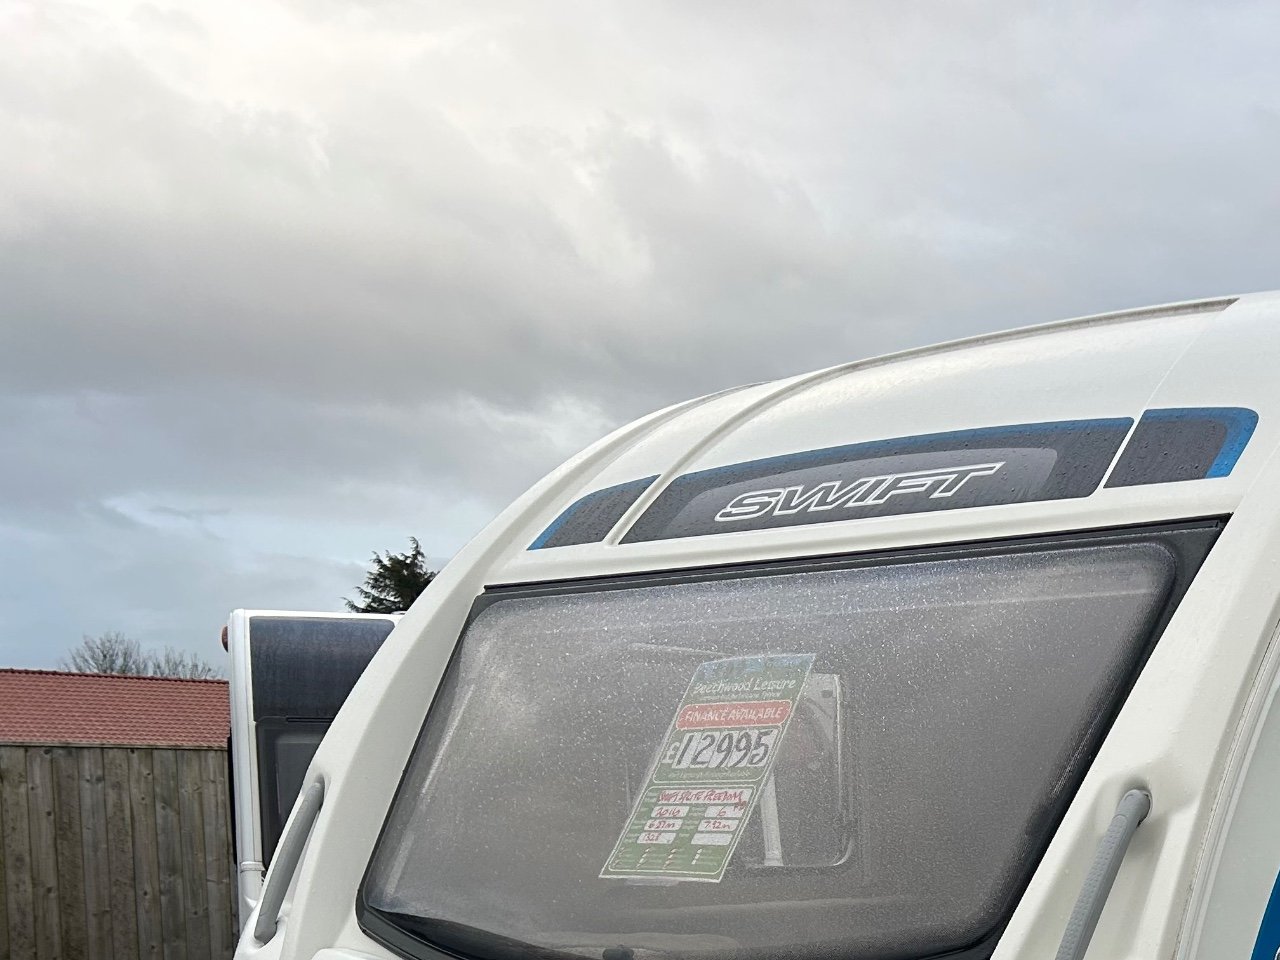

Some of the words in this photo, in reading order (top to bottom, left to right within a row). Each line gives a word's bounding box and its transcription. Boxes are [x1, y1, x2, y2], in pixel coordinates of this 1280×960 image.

[715, 461, 1005, 522] SWIFT
[685, 709, 727, 721] FINANCE
[727, 706, 783, 720] AVAILABLE
